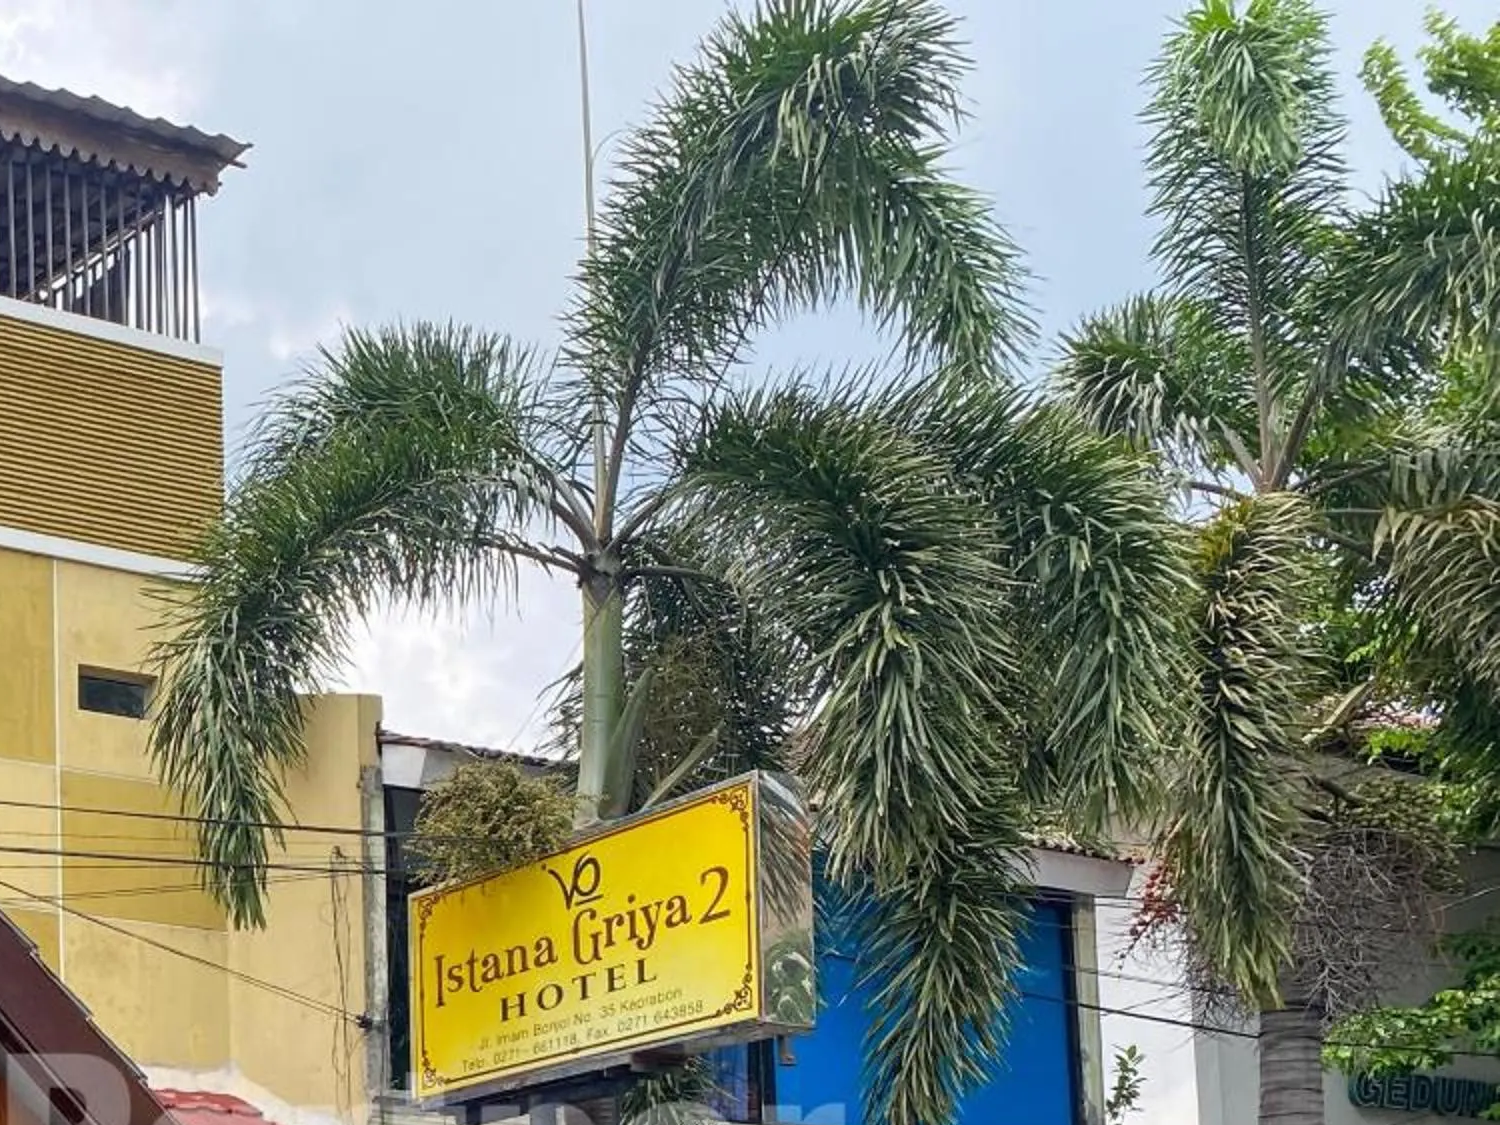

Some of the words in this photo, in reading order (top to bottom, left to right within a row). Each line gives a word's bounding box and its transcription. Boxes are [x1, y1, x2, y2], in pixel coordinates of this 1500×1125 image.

[433, 936, 559, 1008] Istana
[572, 894, 693, 966] Griya
[698, 865, 731, 925] 2
[500, 957, 658, 1022] HOTEL
[496, 1027, 529, 1048] Imam
